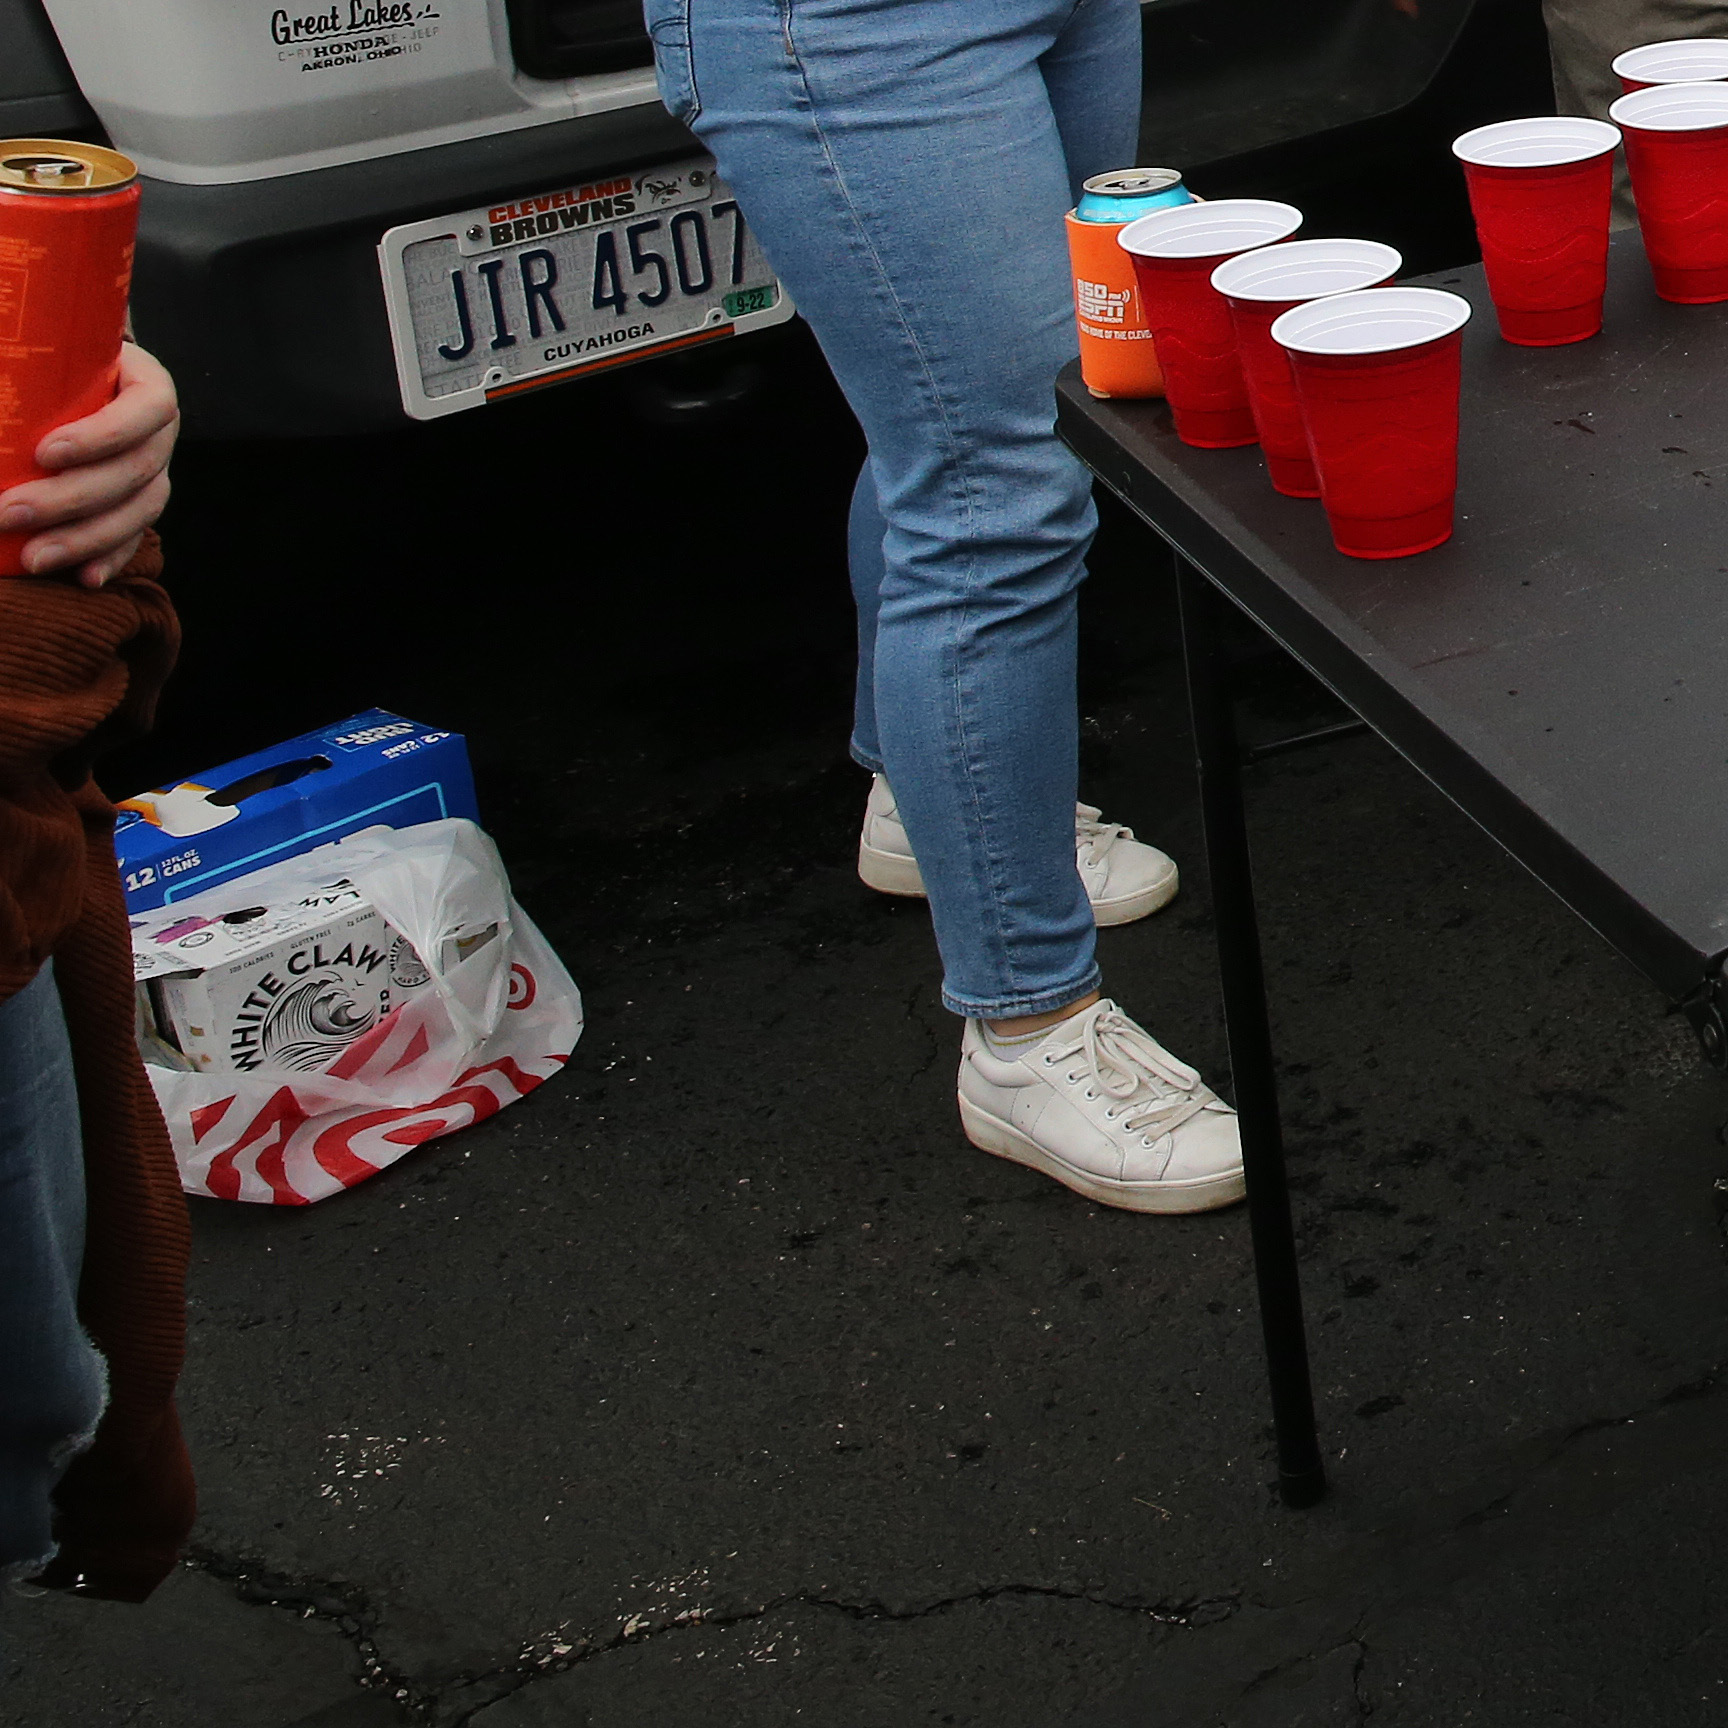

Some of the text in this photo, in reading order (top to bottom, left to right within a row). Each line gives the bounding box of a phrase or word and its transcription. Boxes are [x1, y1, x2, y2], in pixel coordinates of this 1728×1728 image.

[271, 5, 343, 46] Great
[313, 36, 390, 59] HONDA
[487, 177, 633, 225] CLEVELAND
[491, 193, 637, 248] BROWNS
[437, 248, 566, 362] JIR
[591, 199, 746, 317] 4507
[736, 292, 767, 314] 9-22
[543, 322, 656, 363] CUYAHOGA
[125, 855, 202, 892] 12 CANS
[230, 942, 388, 1073] WHITE CLAW
